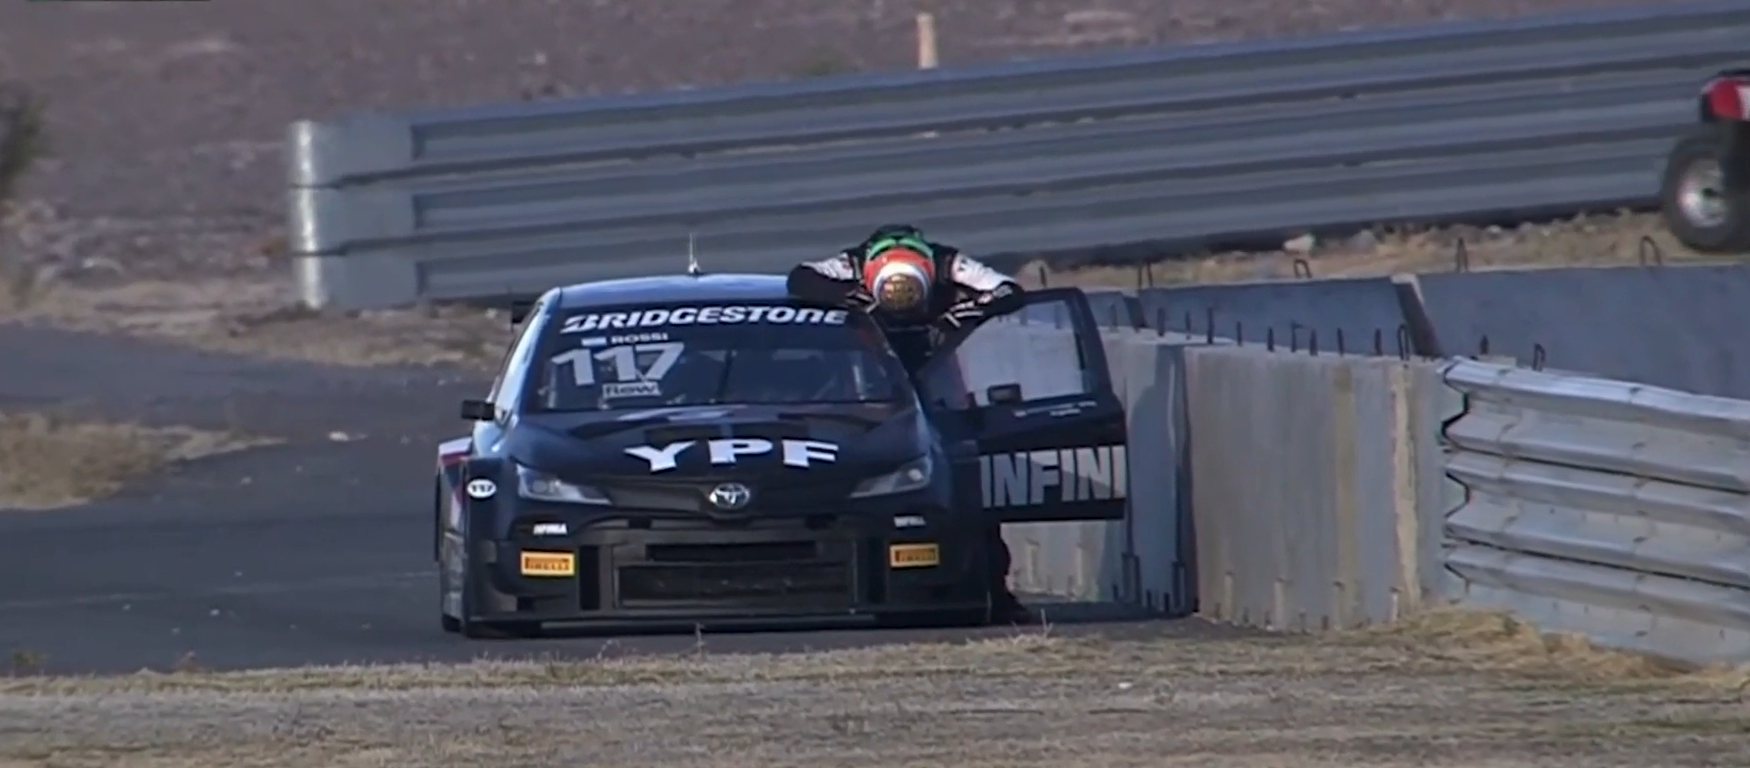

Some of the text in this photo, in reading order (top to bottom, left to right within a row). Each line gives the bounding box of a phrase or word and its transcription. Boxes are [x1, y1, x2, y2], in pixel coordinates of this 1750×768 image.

[611, 331, 670, 344] ROSSI
[551, 341, 685, 386] 117
[624, 438, 840, 472] YPF
[979, 445, 1127, 508] INFINI
